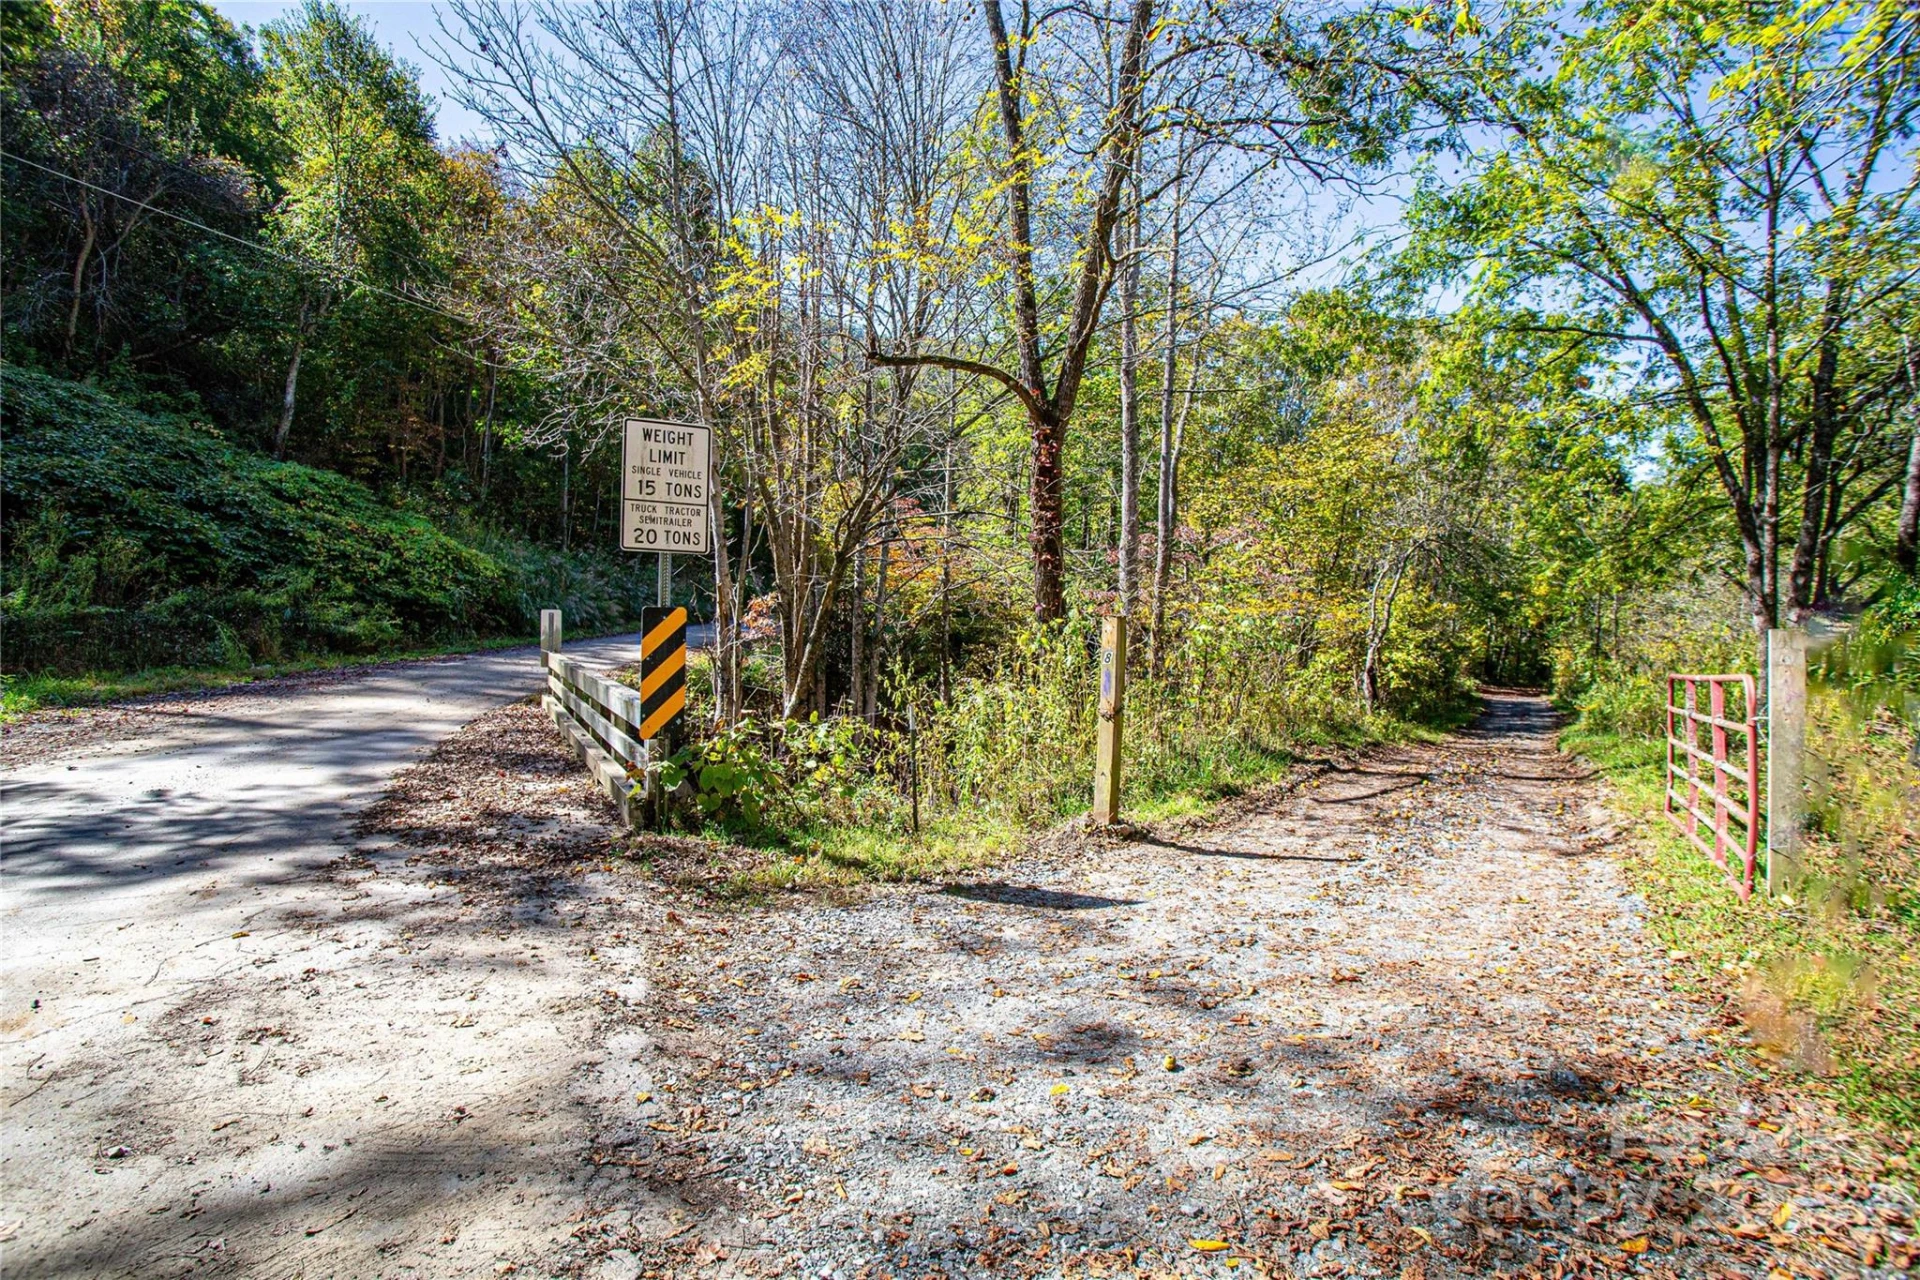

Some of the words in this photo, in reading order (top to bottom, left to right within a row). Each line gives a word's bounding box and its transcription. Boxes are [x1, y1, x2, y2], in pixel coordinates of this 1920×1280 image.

[642, 427, 694, 447] WEIGHT
[649, 448, 686, 466] LIMIT
[631, 465, 662, 477] SINGLE
[668, 468, 702, 480] VEHICLE
[637, 479, 656, 496] 15
[665, 482, 702, 499] TONS
[630, 503, 658, 514] TRUCK
[665, 505, 702, 517] TRACTOR
[638, 515, 693, 528] SEMITRAILER
[633, 527, 658, 544] 20
[664, 530, 701, 546] TONS
[1104, 652, 1112, 664] 8
